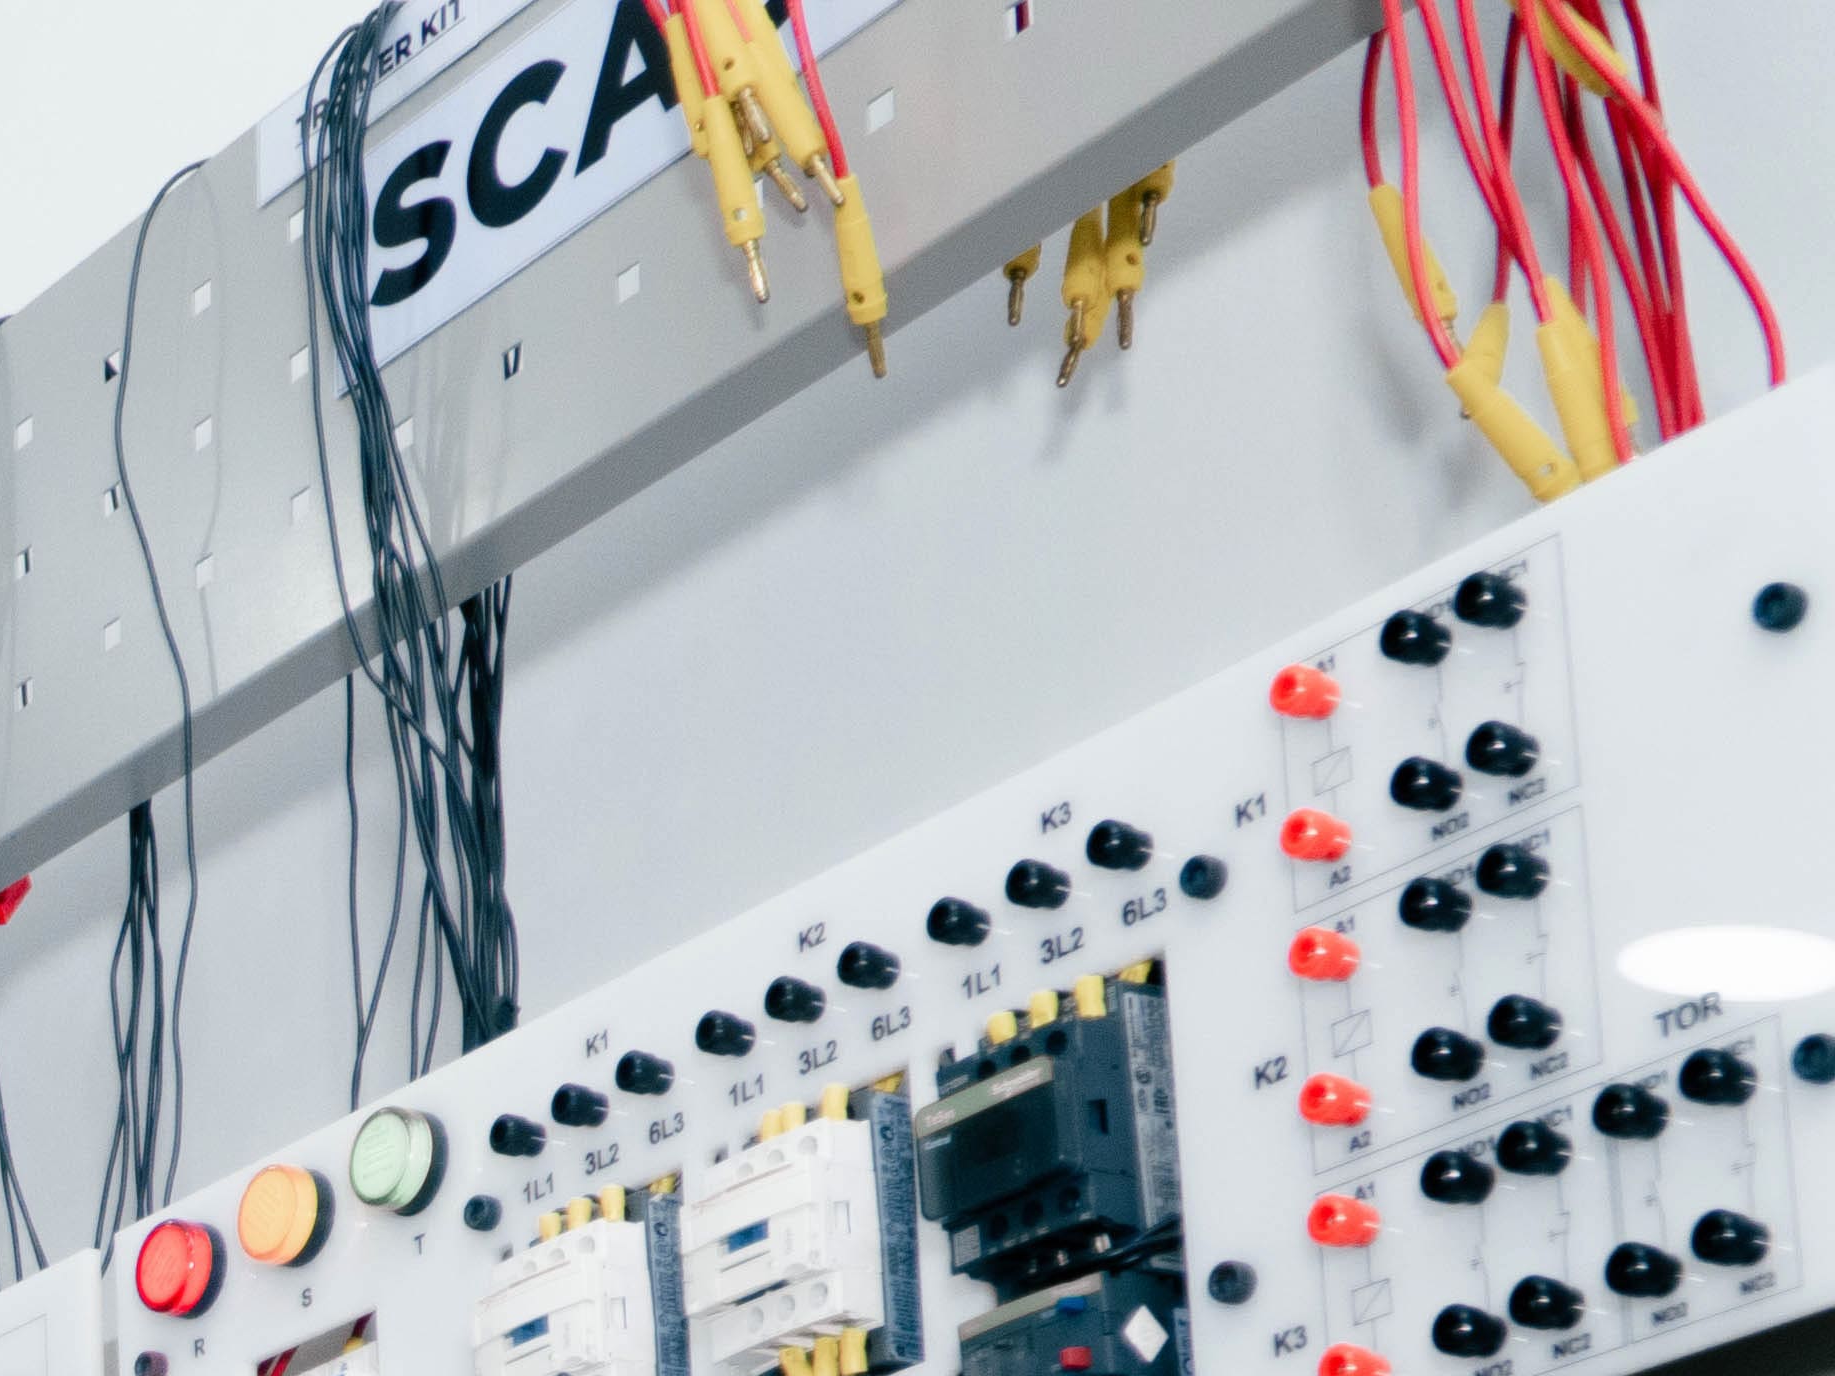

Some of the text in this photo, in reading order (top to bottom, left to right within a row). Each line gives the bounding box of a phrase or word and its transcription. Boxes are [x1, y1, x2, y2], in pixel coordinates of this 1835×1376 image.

[421, 0, 460, 46] KIT
[369, 0, 789, 307] SCA
[1042, 802, 1072, 833] K3
[1236, 795, 1267, 827] K1
[1329, 866, 1351, 887] A2
[799, 922, 826, 952] K2
[961, 889, 1167, 999] 1L1 3L2 6L3
[1656, 993, 1723, 1036] TOR
[586, 1031, 610, 1058] K1
[730, 1008, 912, 1106] 1L1 3L2 6L3
[1255, 1056, 1287, 1088] K2
[1350, 1132, 1372, 1151] A2
[522, 1113, 685, 1204] 1L1 3L2 6L3
[415, 1233, 425, 1255] T
[302, 1288, 312, 1306] S
[194, 1339, 205, 1357] R
[1273, 1327, 1307, 1357] K3
